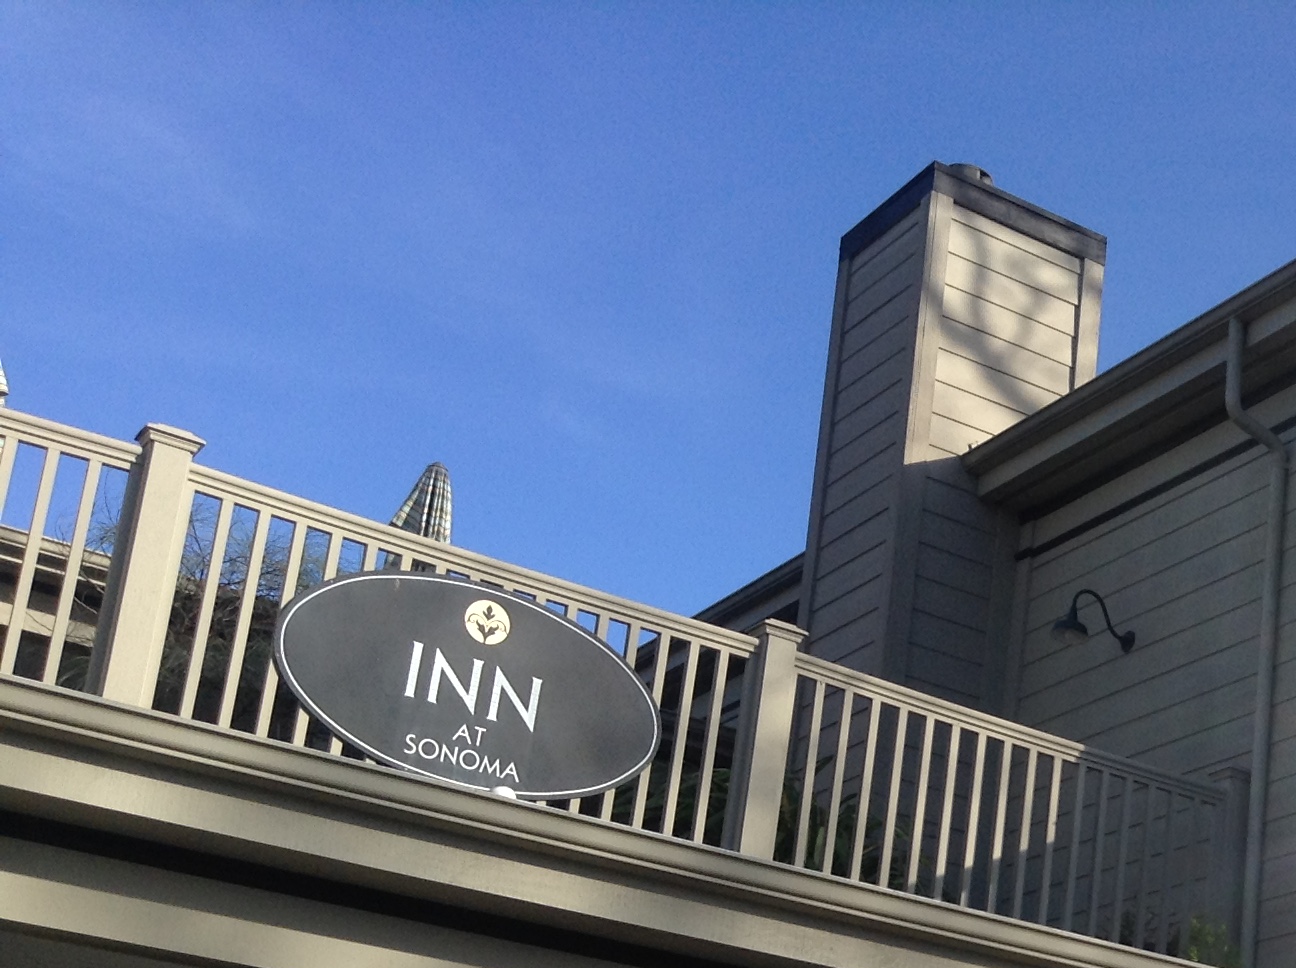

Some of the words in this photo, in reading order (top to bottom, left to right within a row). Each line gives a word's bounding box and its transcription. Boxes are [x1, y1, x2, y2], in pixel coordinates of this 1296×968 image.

[404, 640, 543, 733] INN
[403, 734, 520, 783] SONOMA
[452, 723, 487, 747] AT
